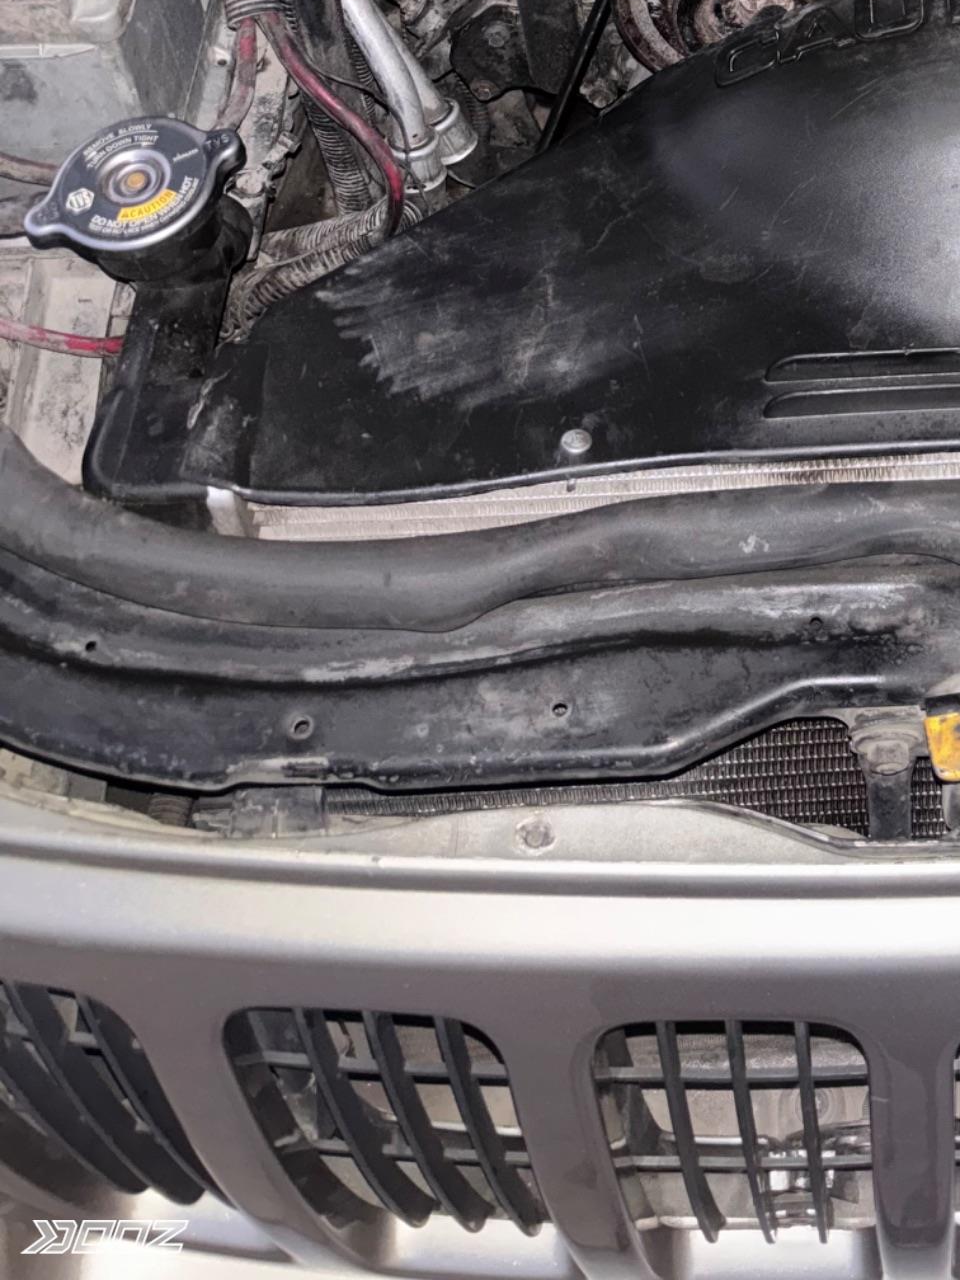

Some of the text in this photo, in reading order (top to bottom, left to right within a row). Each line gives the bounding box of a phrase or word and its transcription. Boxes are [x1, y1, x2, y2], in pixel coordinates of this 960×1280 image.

[118, 123, 152, 138] SLOWLY
[107, 138, 132, 154] DOWN
[133, 135, 159, 144] TIGHT
[91, 214, 107, 226] DO
[107, 218, 126, 228] NOT
[179, 175, 193, 195] HOT
[129, 190, 174, 218] CAUTION
